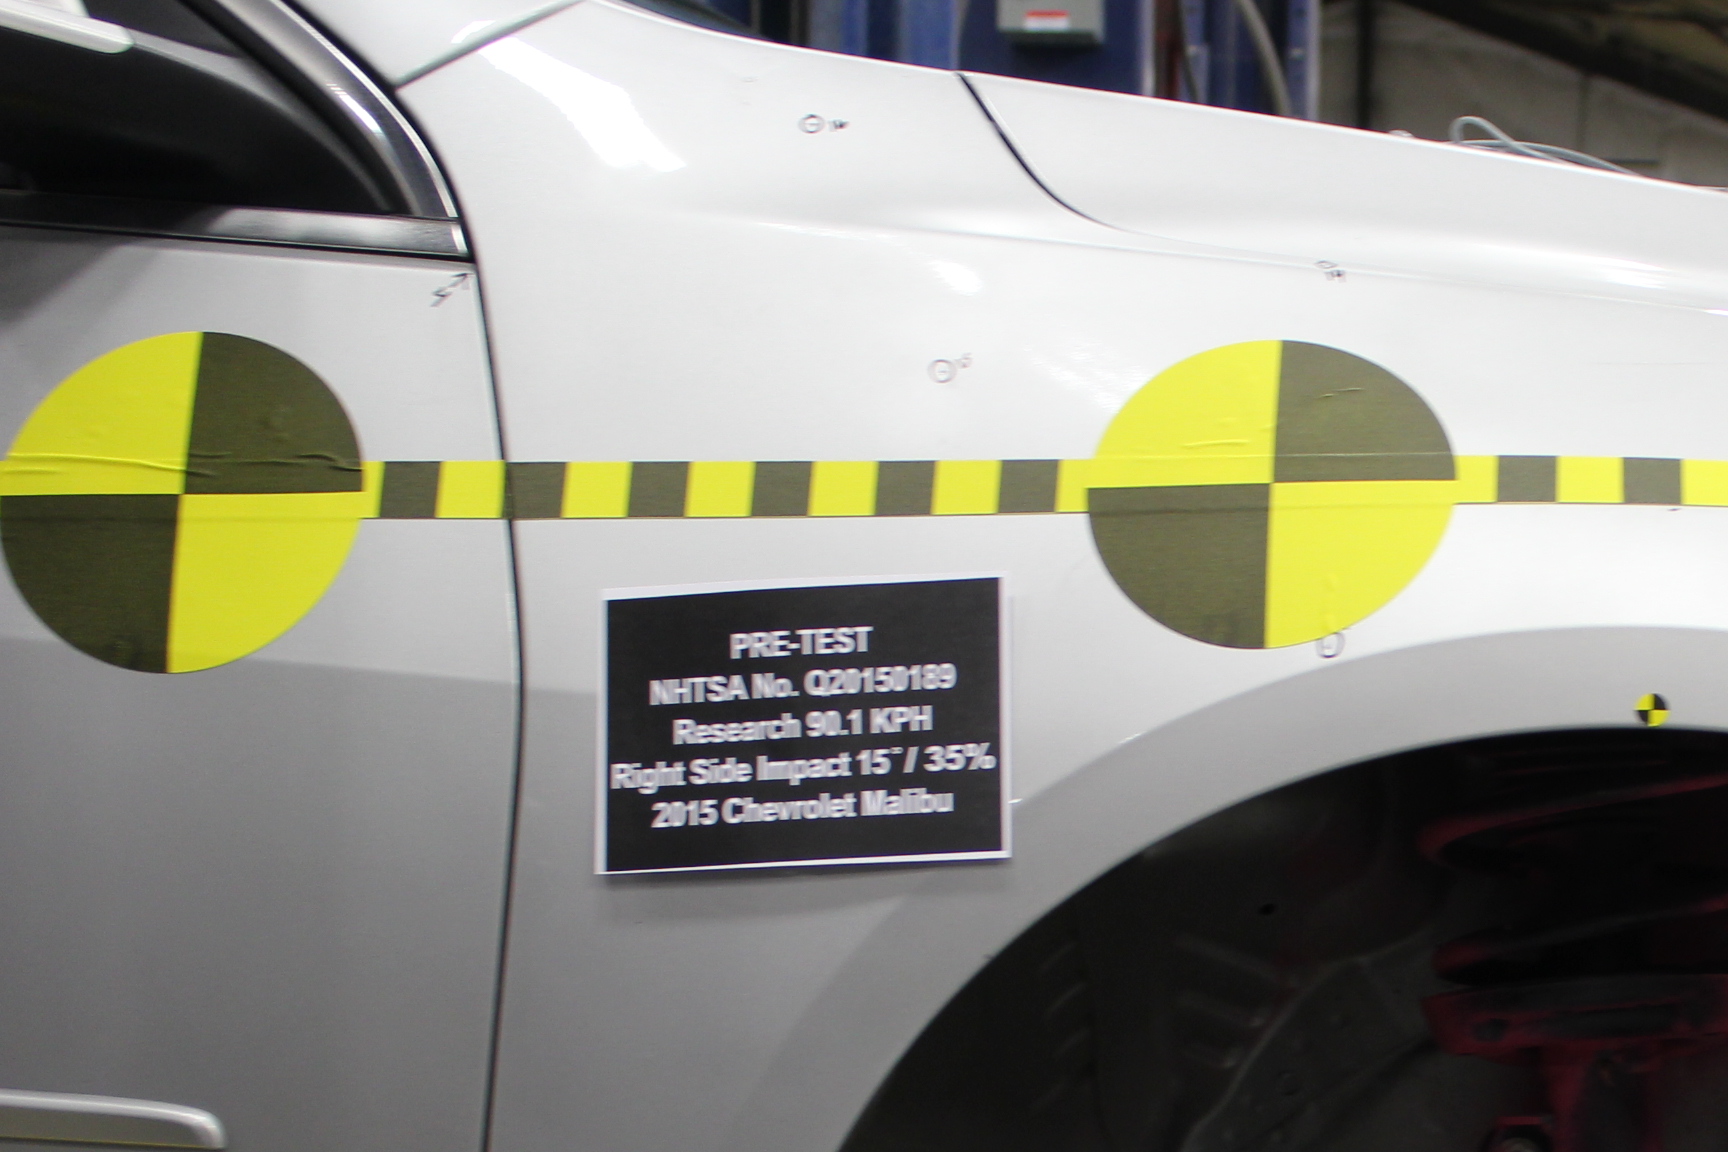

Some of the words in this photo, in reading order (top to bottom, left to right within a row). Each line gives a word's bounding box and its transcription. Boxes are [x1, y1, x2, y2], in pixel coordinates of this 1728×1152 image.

[730, 625, 873, 659] PRE-TEST
[649, 675, 749, 705] NHTSA
[751, 672, 799, 698] No.
[672, 713, 801, 744] Research
[806, 709, 863, 738] 90.1
[869, 705, 933, 733] KPH
[610, 762, 686, 794] Right
[689, 758, 752, 785] Side
[756, 752, 853, 785] Impact
[924, 743, 997, 772] 35%
[651, 800, 719, 829] 2015
[722, 793, 858, 824] Chevrolet
[860, 788, 955, 817] Malibu
